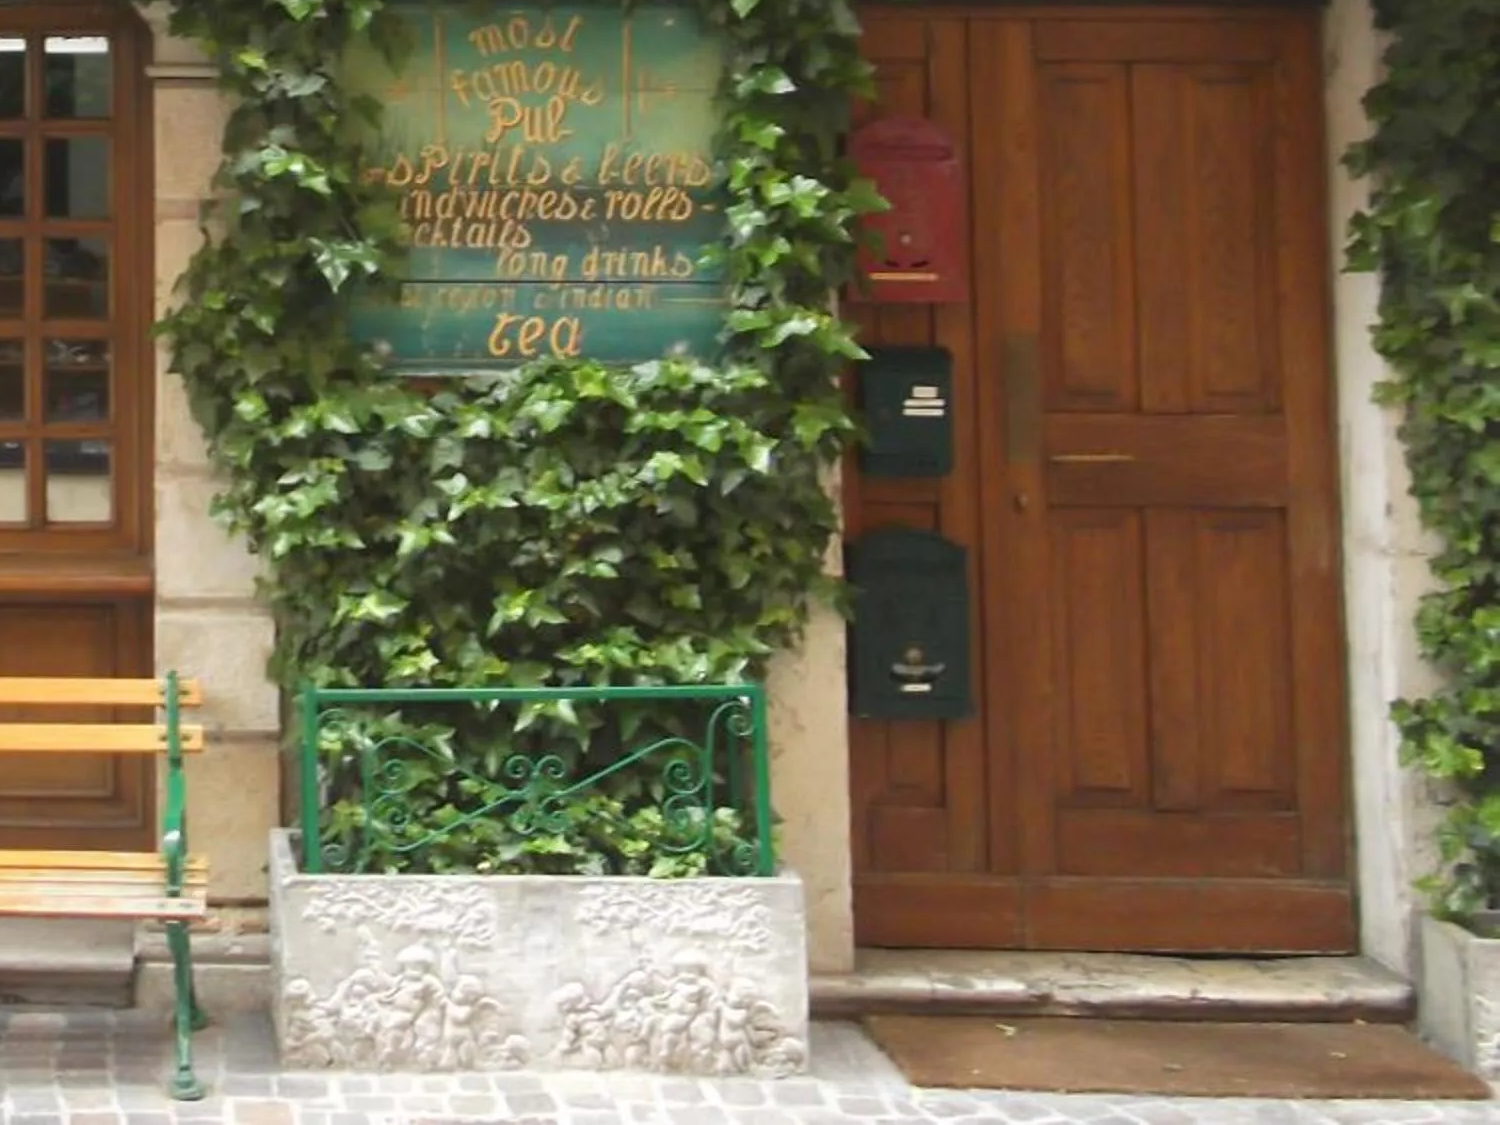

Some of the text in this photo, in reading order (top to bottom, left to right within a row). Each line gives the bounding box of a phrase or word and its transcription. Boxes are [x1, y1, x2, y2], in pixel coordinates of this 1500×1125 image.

[484, 95, 575, 144] Pub
[598, 141, 712, 187] beers
[401, 186, 578, 221] ndwiches
[603, 186, 693, 221] rolls
[414, 216, 532, 249] cktails
[497, 244, 694, 288] long drinks
[488, 312, 582, 360] tea
